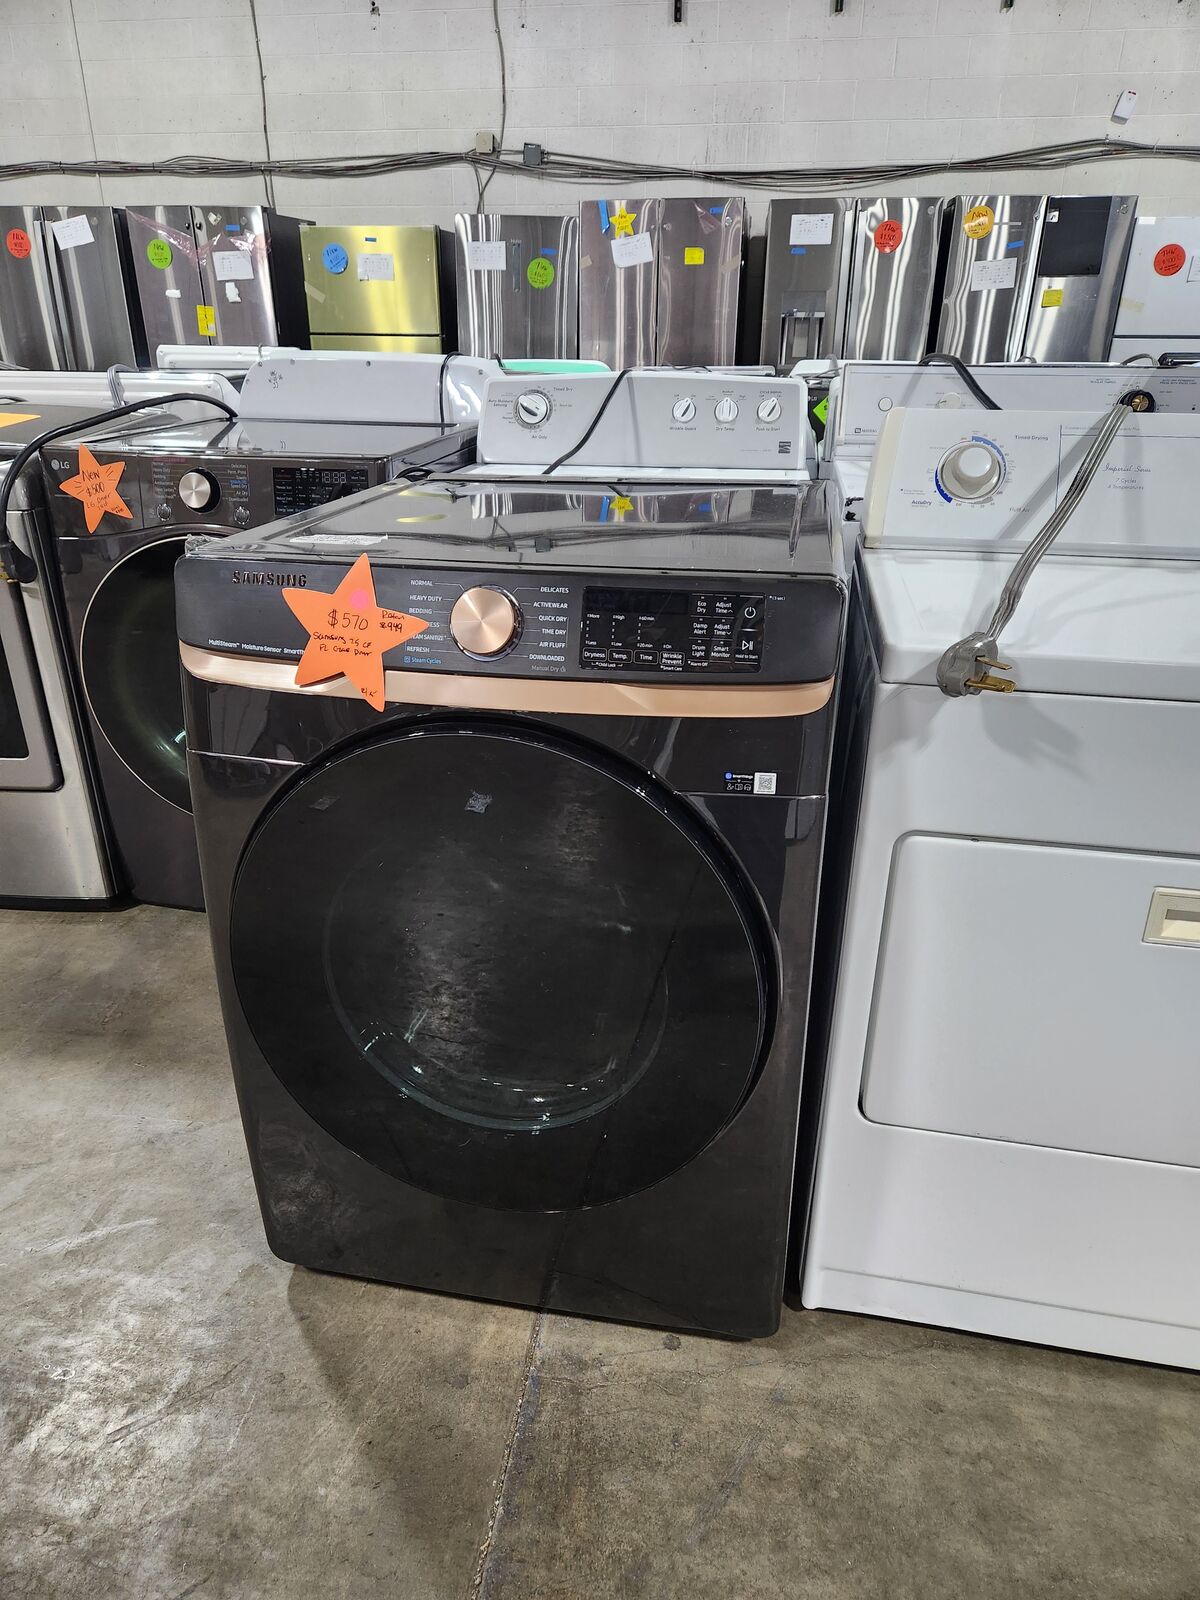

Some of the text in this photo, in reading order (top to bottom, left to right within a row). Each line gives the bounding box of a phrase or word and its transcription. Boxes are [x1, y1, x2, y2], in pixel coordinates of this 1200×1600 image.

[60, 461, 70, 469] LG
[82, 470, 100, 482] New
[232, 570, 307, 587] SAMSUNG
[327, 609, 369, 631] $570
[241, 643, 264, 651] Moisture
[264, 646, 282, 654] Sensor
[529, 653, 565, 661] DOWNLOADED
[584, 652, 606, 660] Dryness
